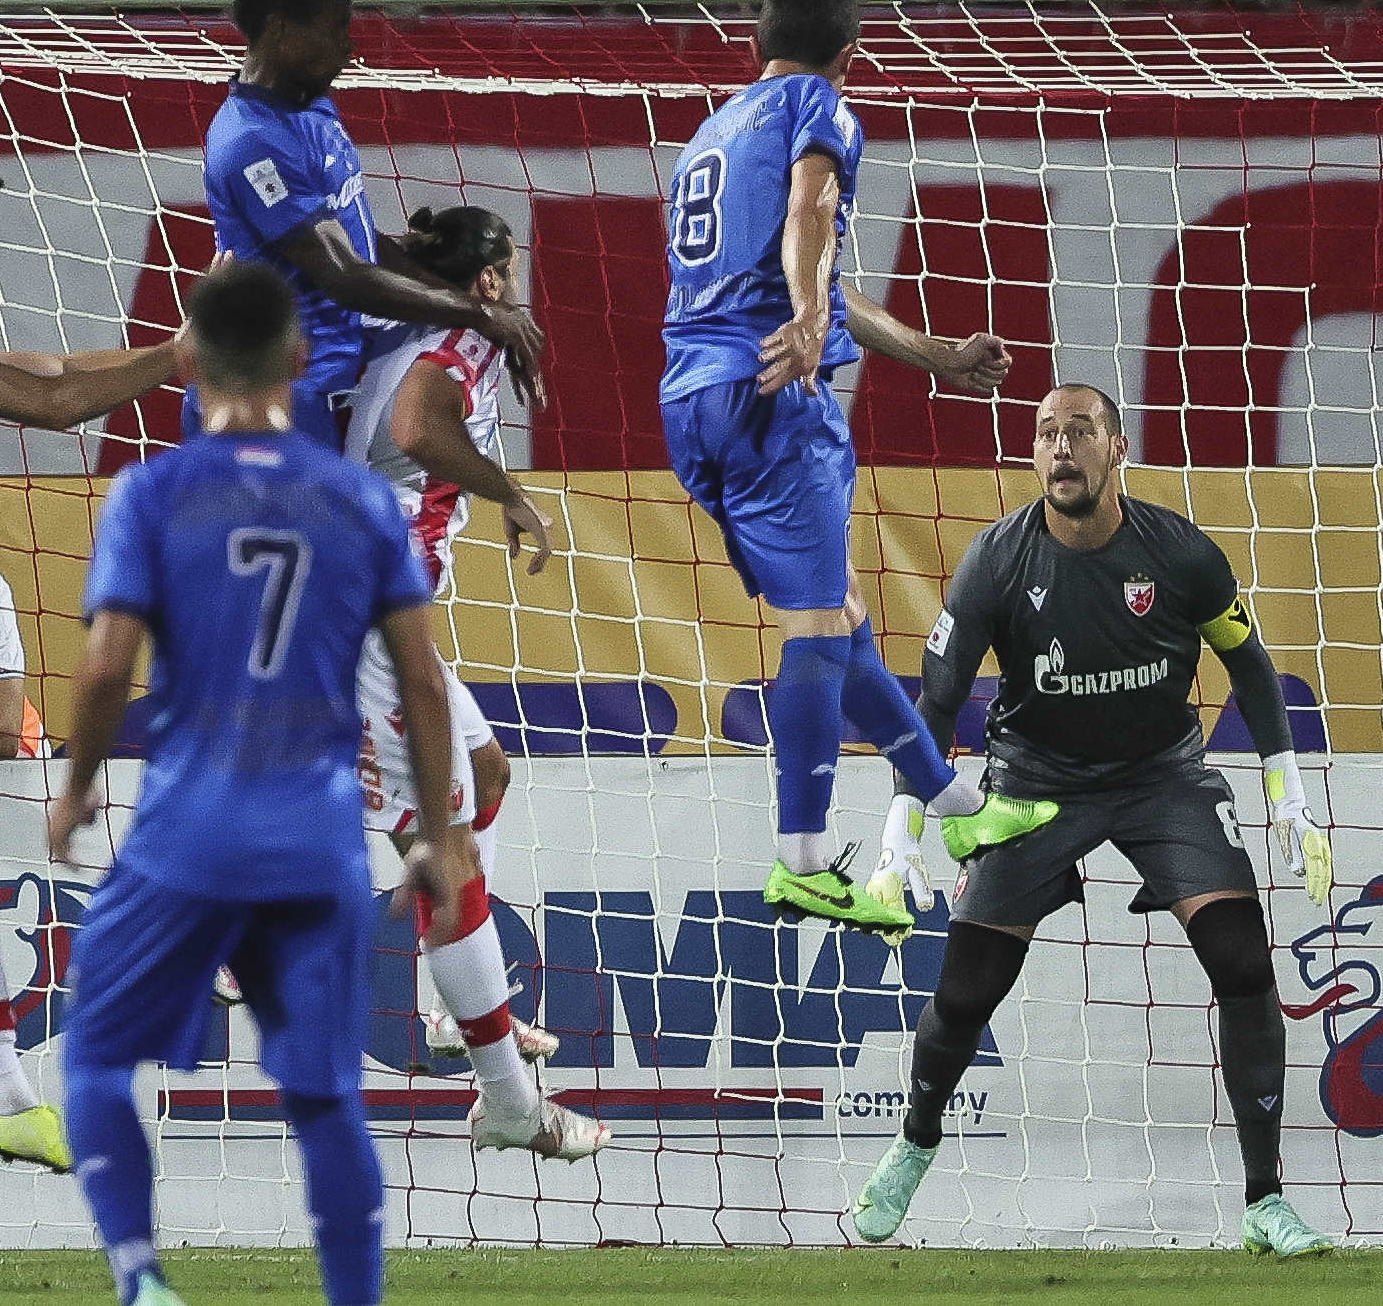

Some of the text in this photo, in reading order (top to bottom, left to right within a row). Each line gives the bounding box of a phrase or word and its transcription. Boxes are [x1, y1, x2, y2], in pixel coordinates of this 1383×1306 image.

[671, 147, 727, 268] 8
[226, 527, 314, 680] 7
[1071, 657, 1168, 696] GAZPROM
[835, 1090, 989, 1127] comny
